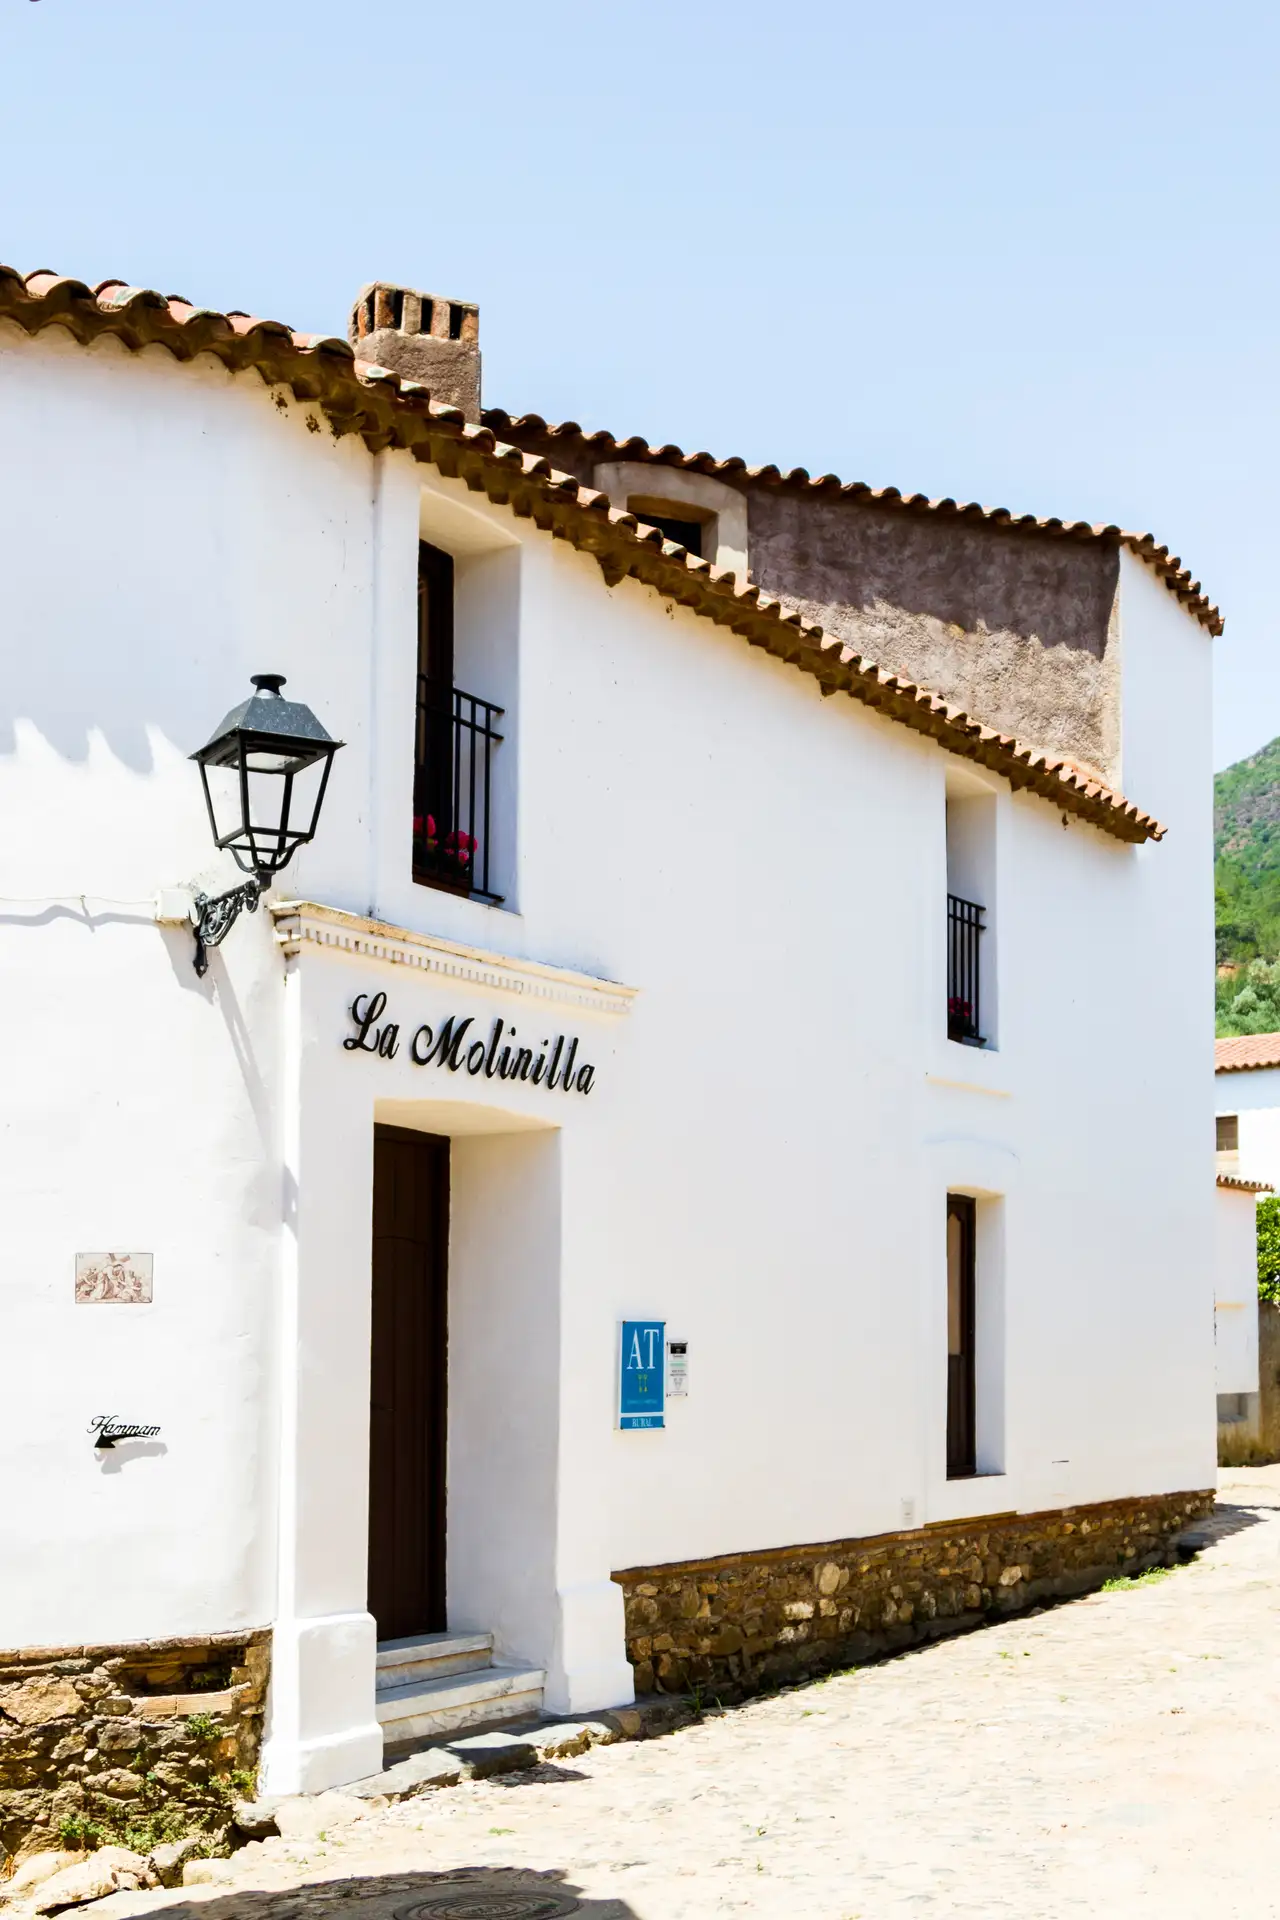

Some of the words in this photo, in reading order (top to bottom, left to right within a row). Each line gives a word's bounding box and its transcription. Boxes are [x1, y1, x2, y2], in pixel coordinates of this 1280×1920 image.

[343, 992, 399, 1059] La
[412, 1015, 595, 1095] Molinilla
[626, 1328, 659, 1369] AT
[86, 1415, 161, 1436] Hammam
